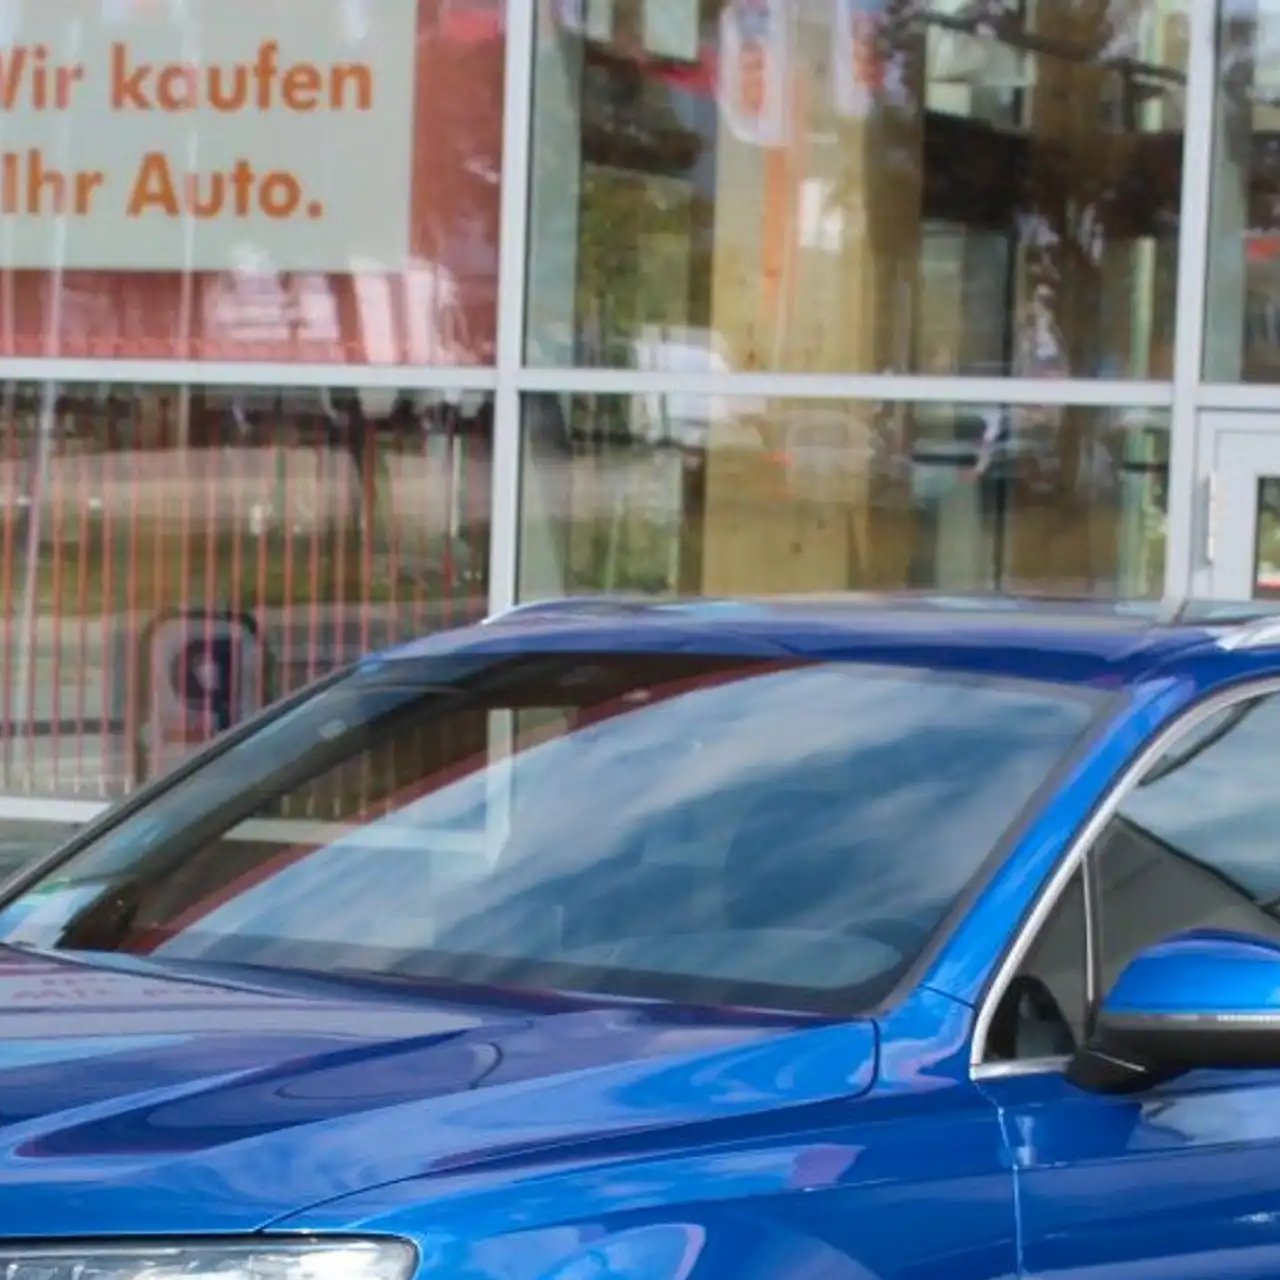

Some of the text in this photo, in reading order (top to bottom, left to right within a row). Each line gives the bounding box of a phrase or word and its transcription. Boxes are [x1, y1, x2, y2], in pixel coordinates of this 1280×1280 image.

[109, 40, 373, 111] kaufen
[0, 148, 324, 220] Ihr Auto.
